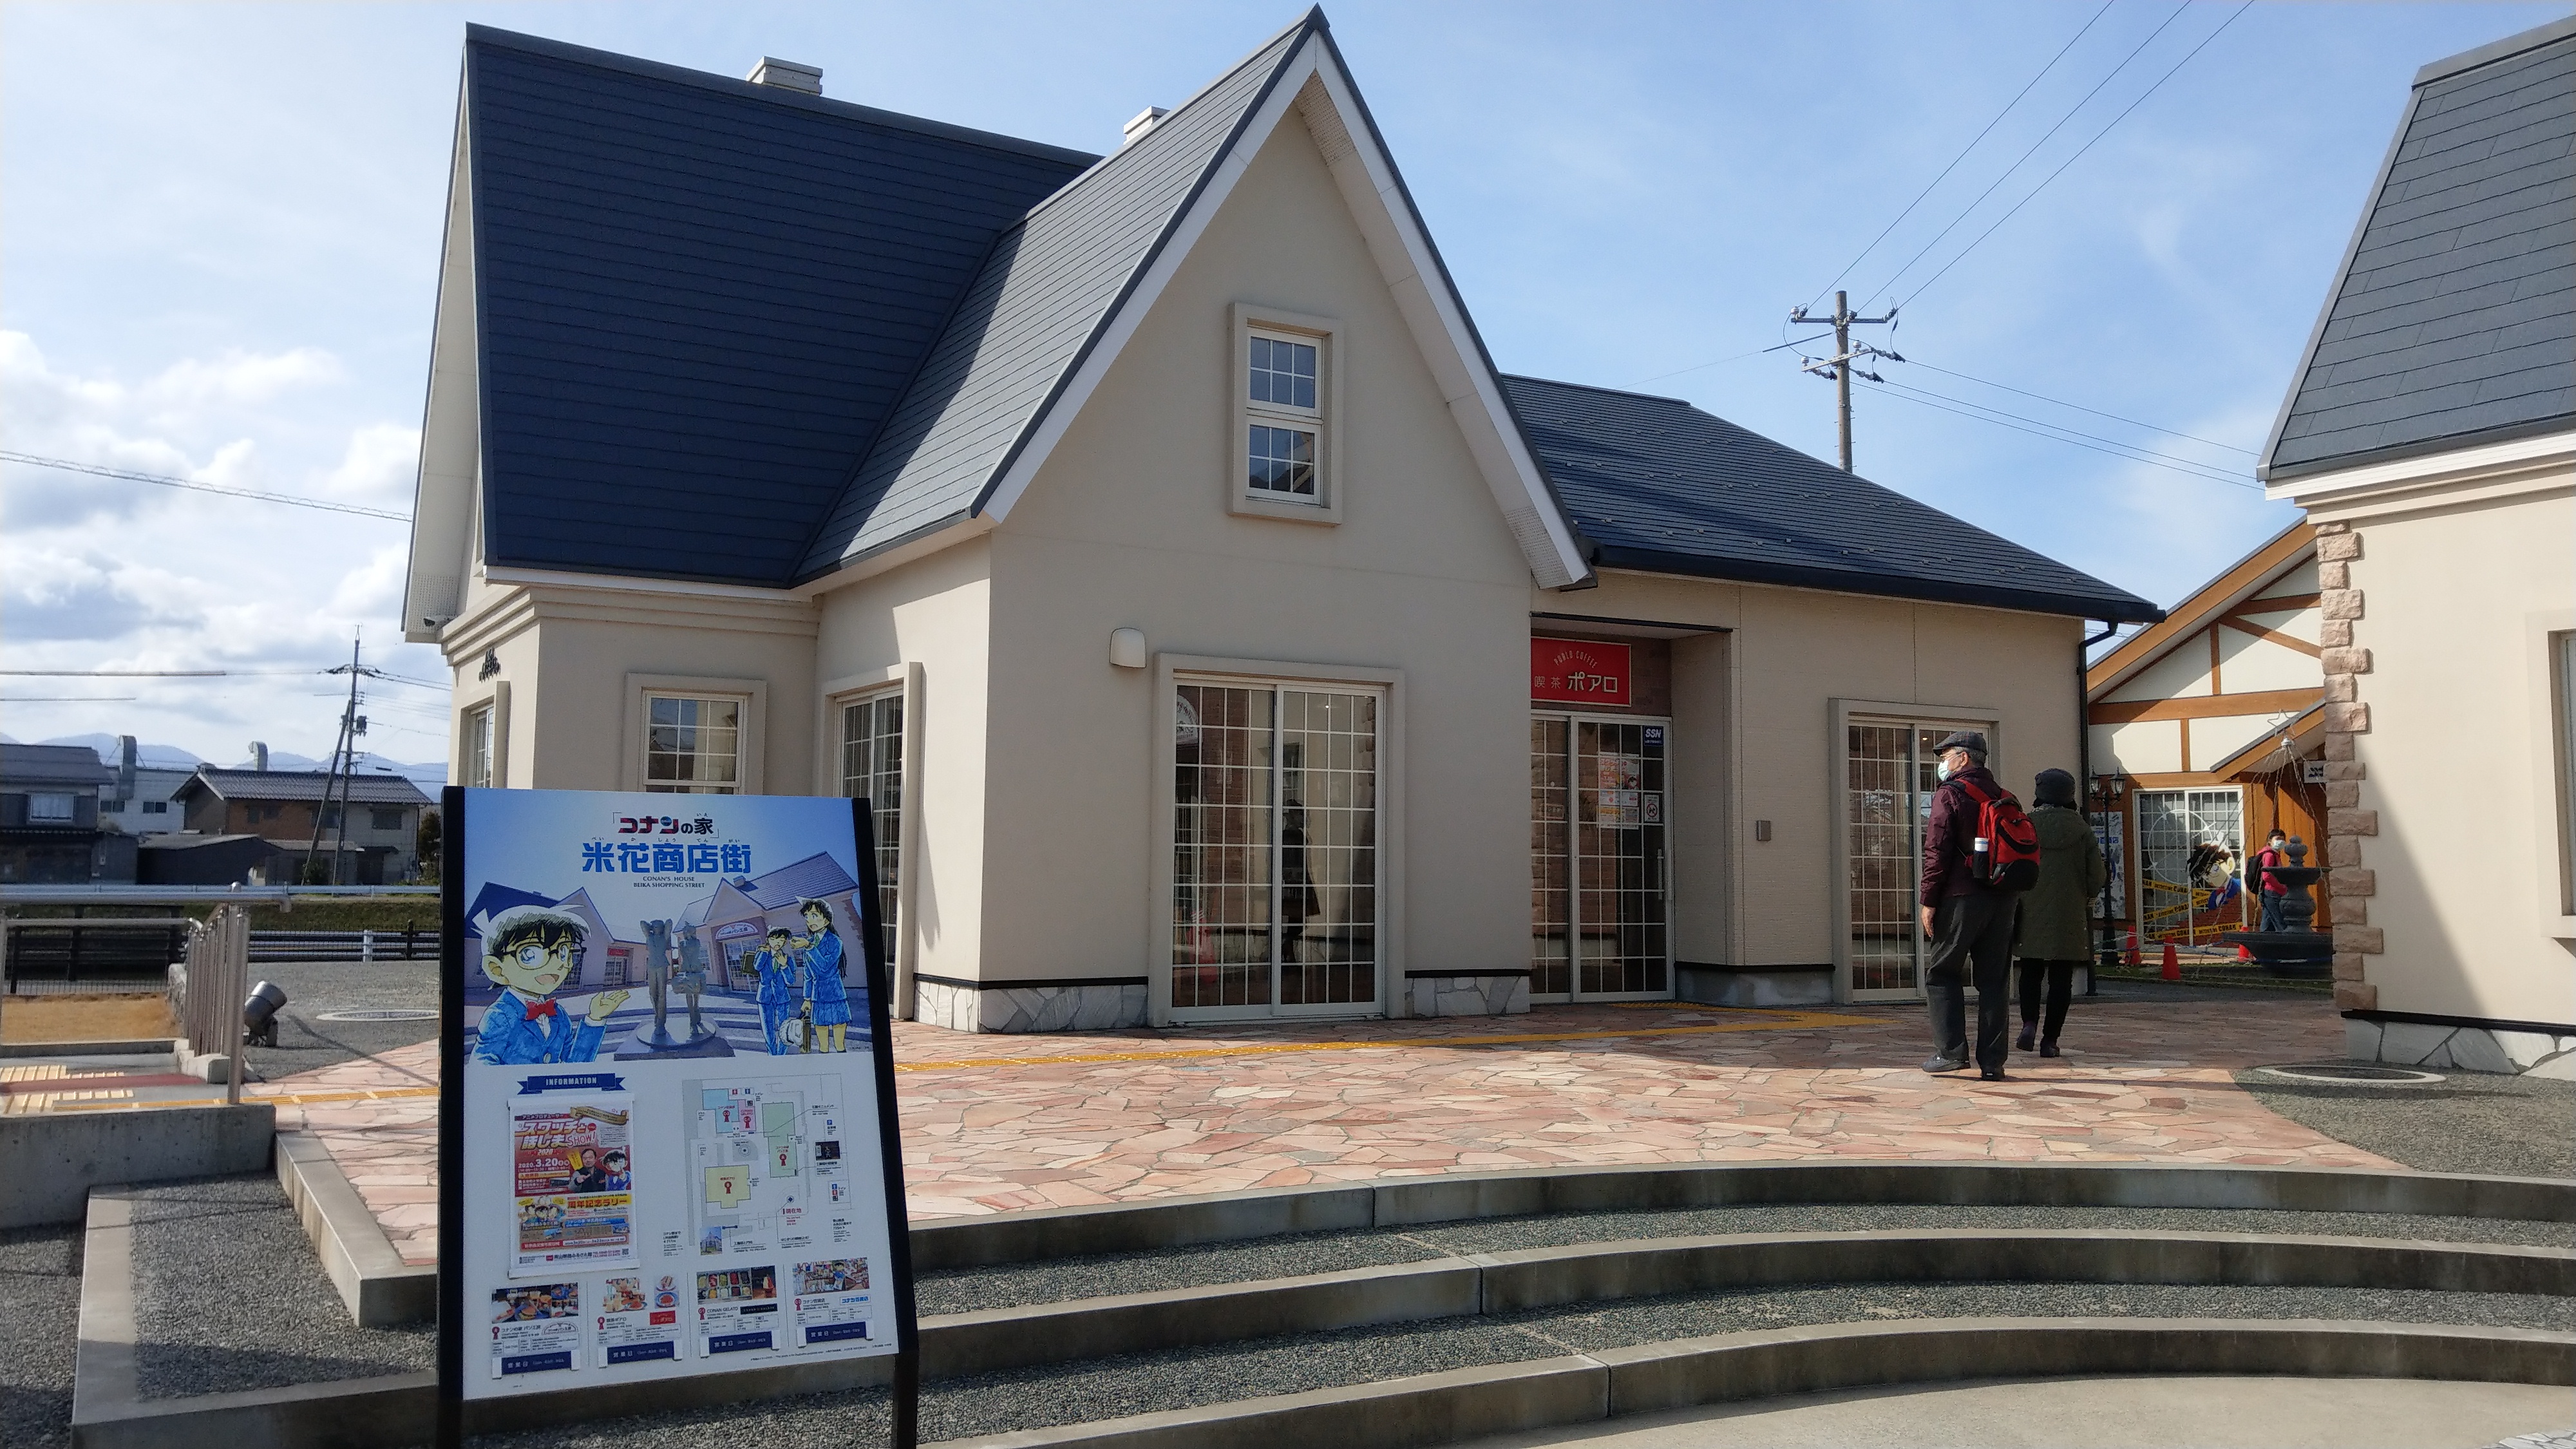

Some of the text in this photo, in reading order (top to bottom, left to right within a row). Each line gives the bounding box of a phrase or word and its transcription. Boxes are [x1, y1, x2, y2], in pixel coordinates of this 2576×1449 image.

[1576, 650, 1598, 668] COFFEE
[1535, 671, 1618, 693] 喫茶 ポアロ
[1645, 728, 1662, 738] SSN
[582, 842, 752, 873] 米花商店街
[545, 1077, 597, 1086] INFORMATION
